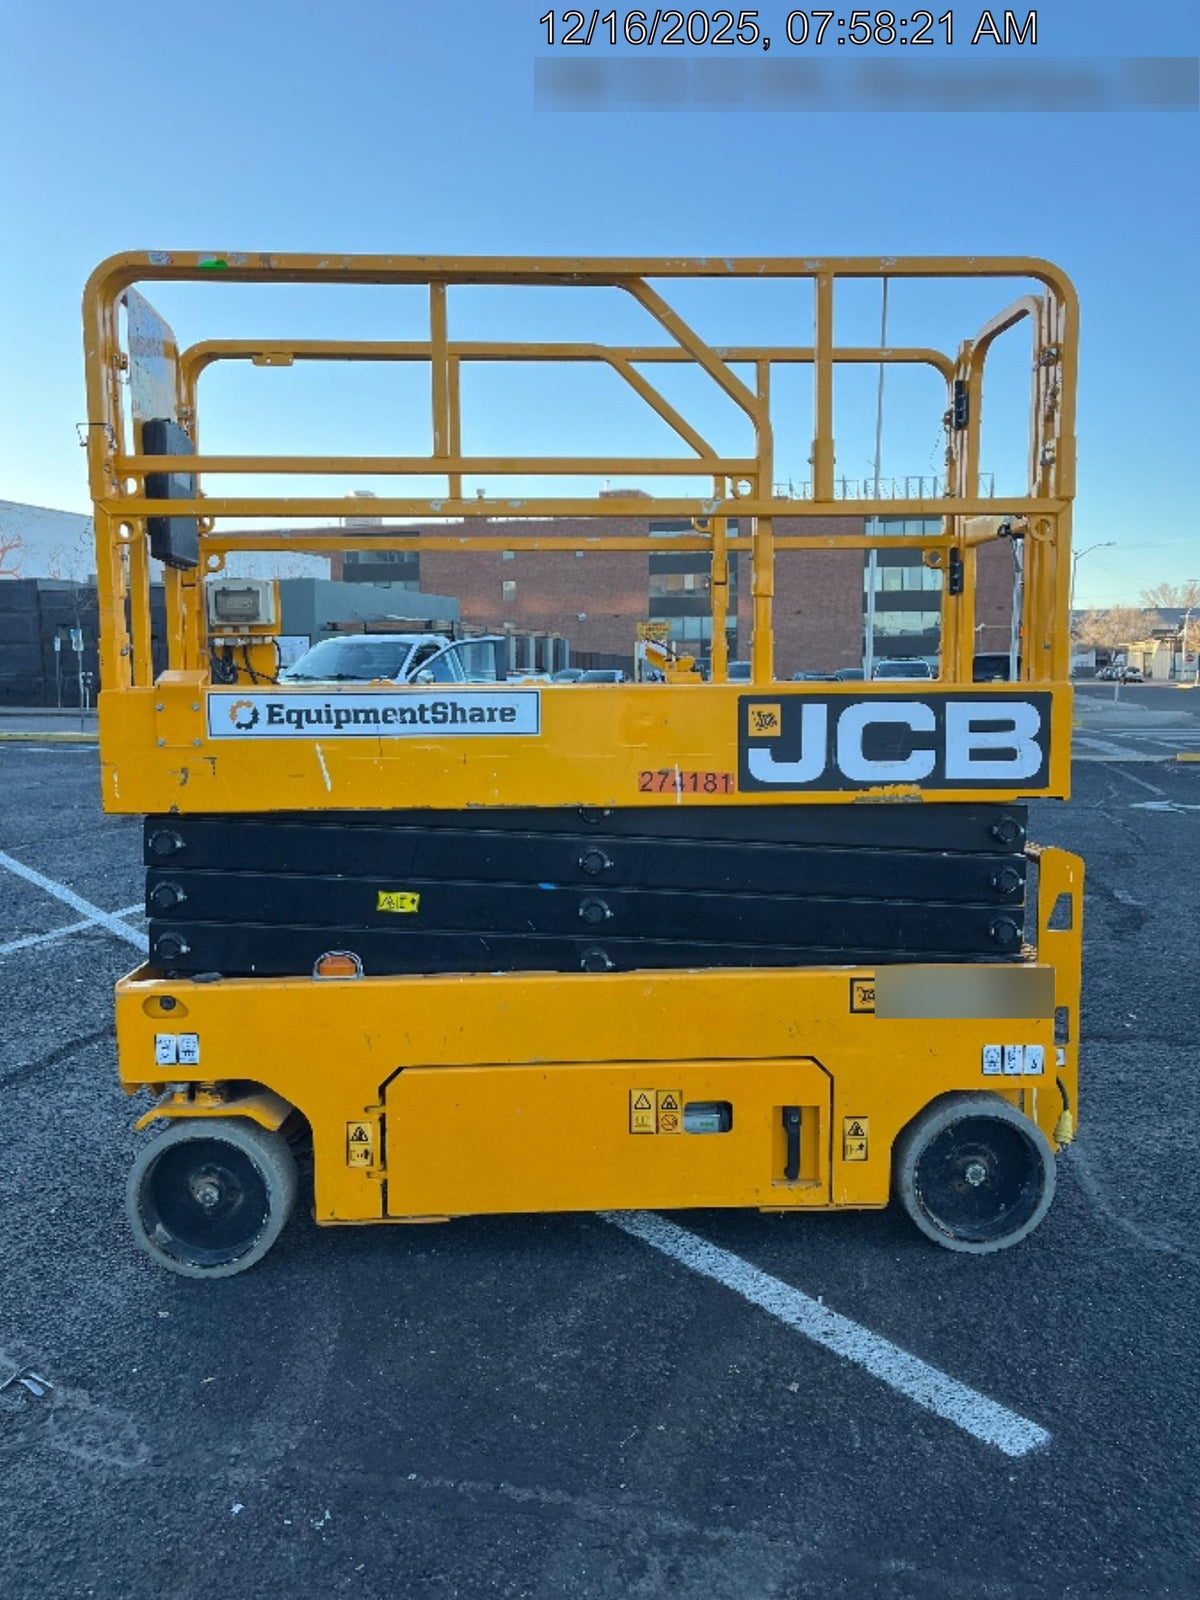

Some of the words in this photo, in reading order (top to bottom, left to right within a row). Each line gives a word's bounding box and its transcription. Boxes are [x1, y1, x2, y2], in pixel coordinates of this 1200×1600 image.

[265, 702, 517, 730] EquipmentShare
[748, 702, 1043, 783] JCB
[640, 771, 730, 793] 274181
